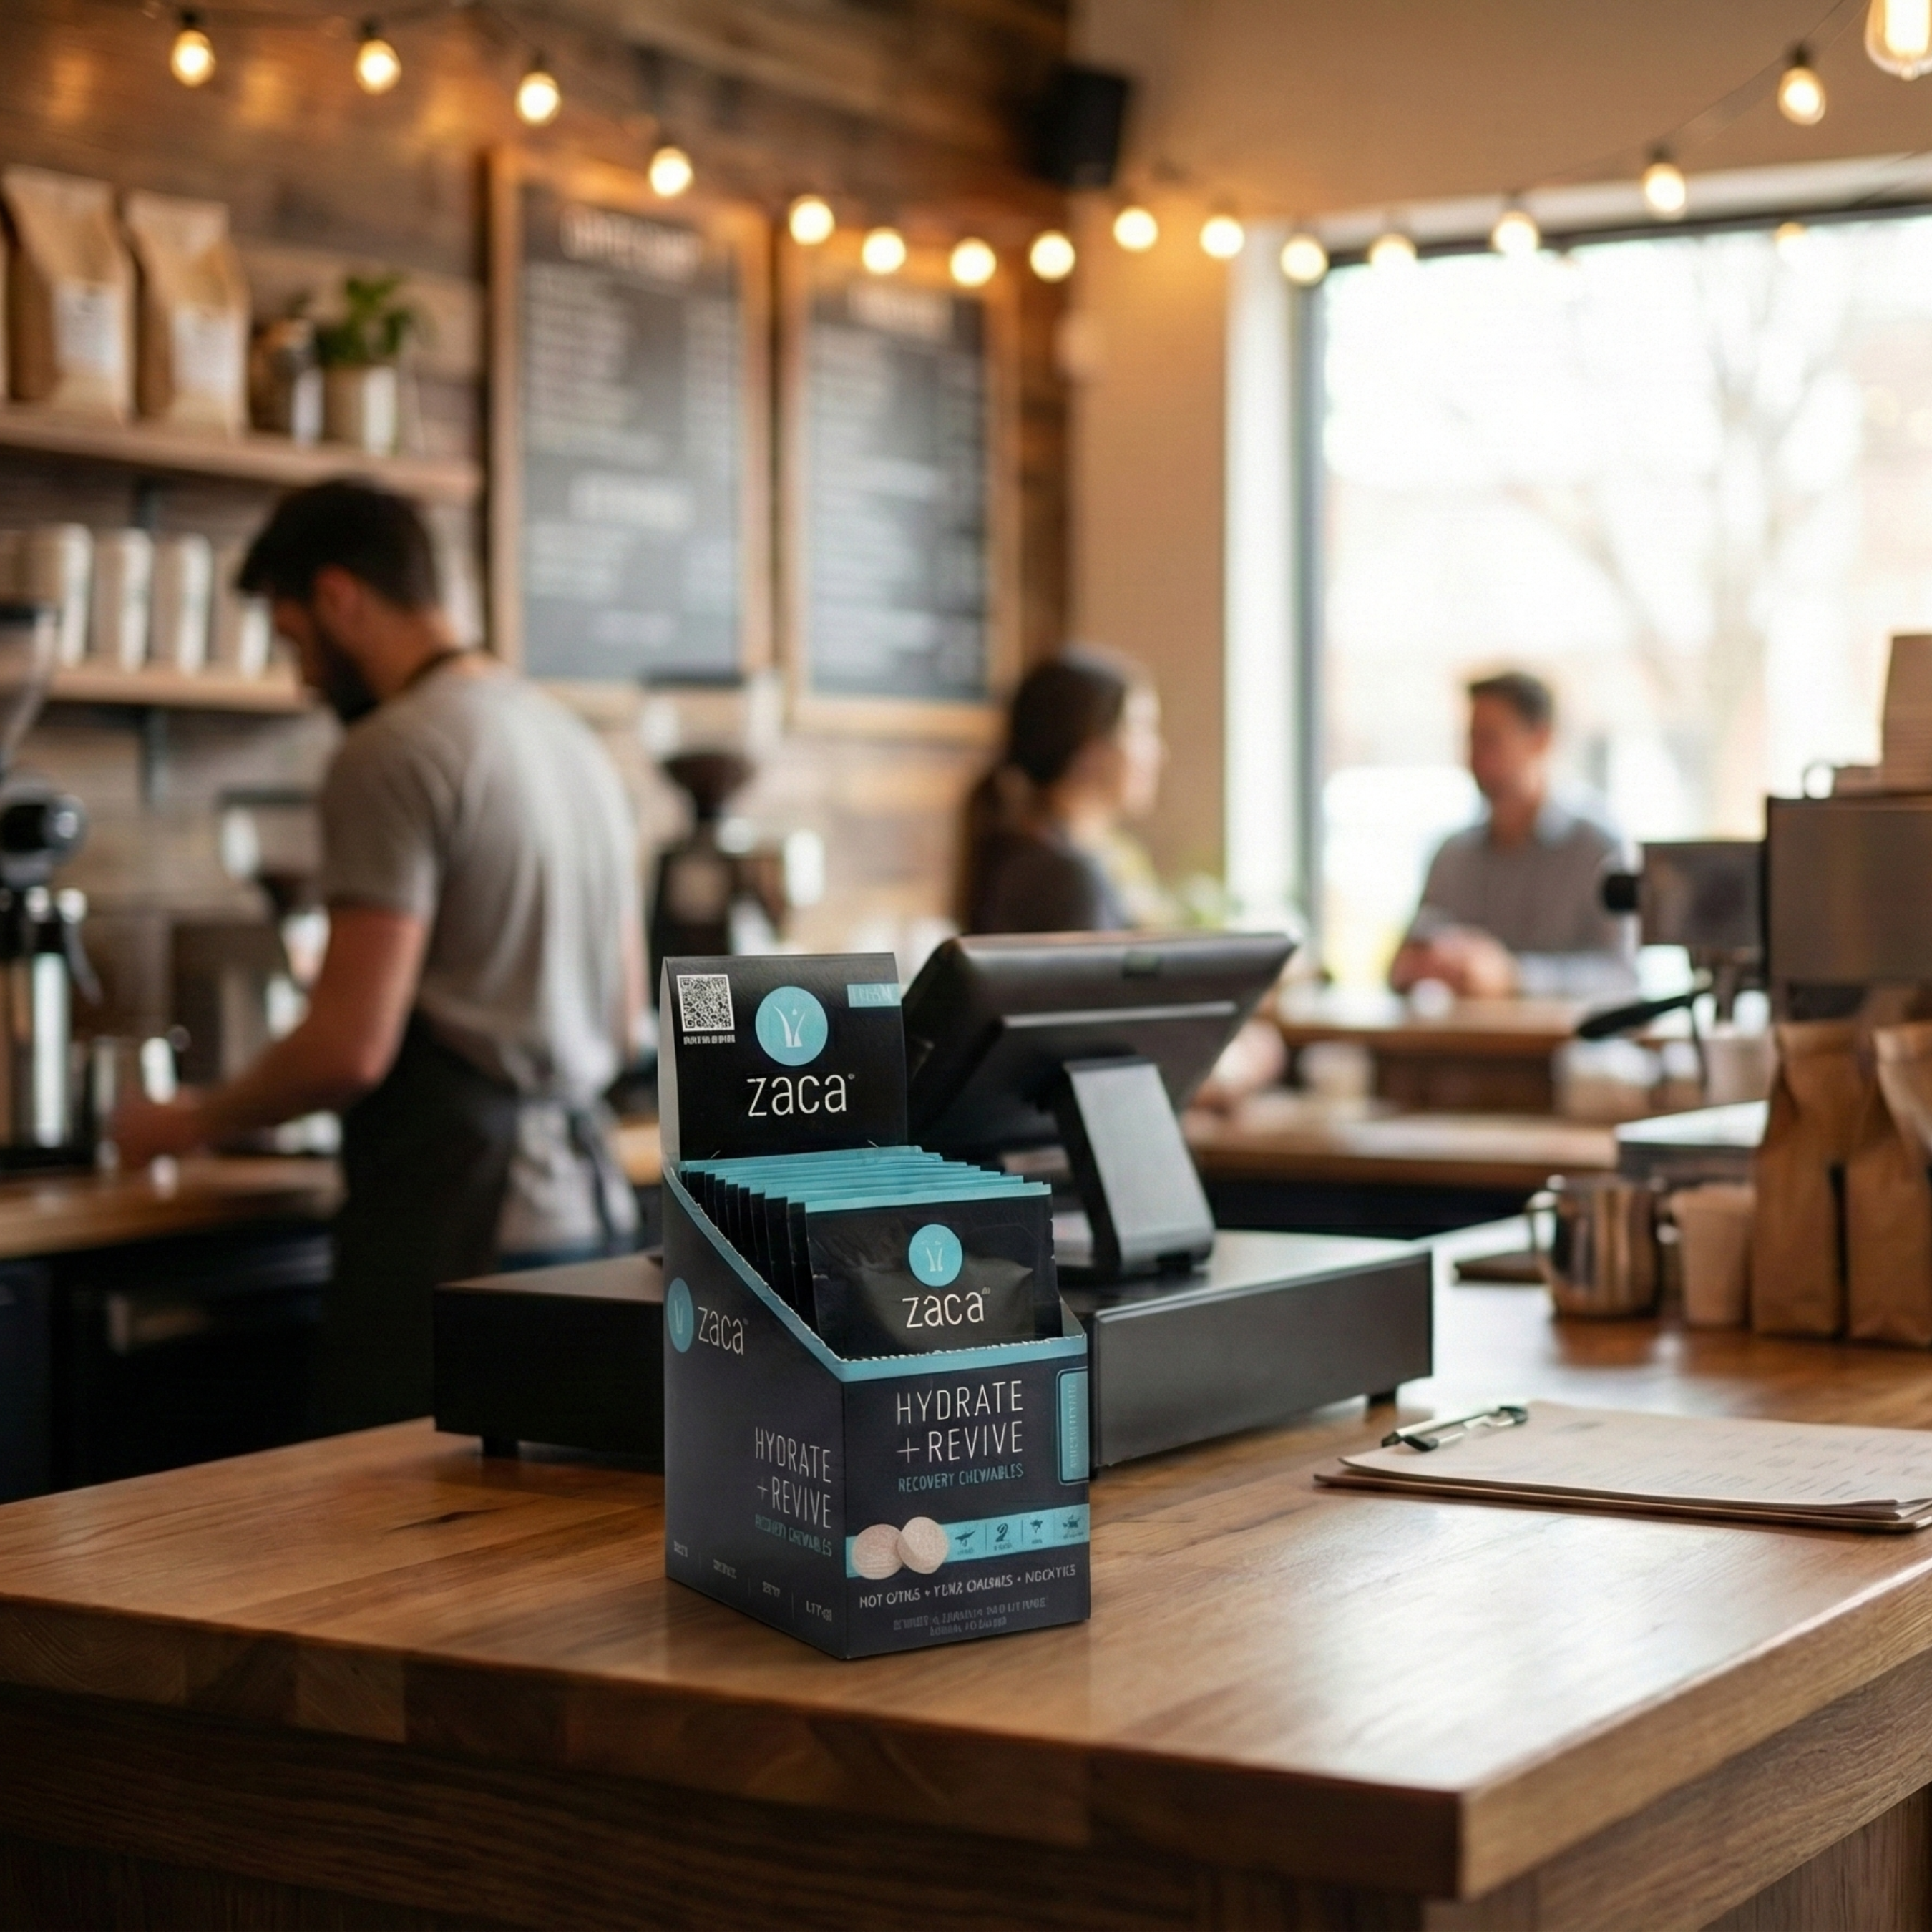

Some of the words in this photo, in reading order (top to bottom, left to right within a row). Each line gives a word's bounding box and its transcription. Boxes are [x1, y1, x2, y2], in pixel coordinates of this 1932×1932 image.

[896, 1380, 1024, 1425] HYDRATE
[755, 1426, 831, 1483] HYDRATE
[897, 1473, 955, 1493] RECOVERY
